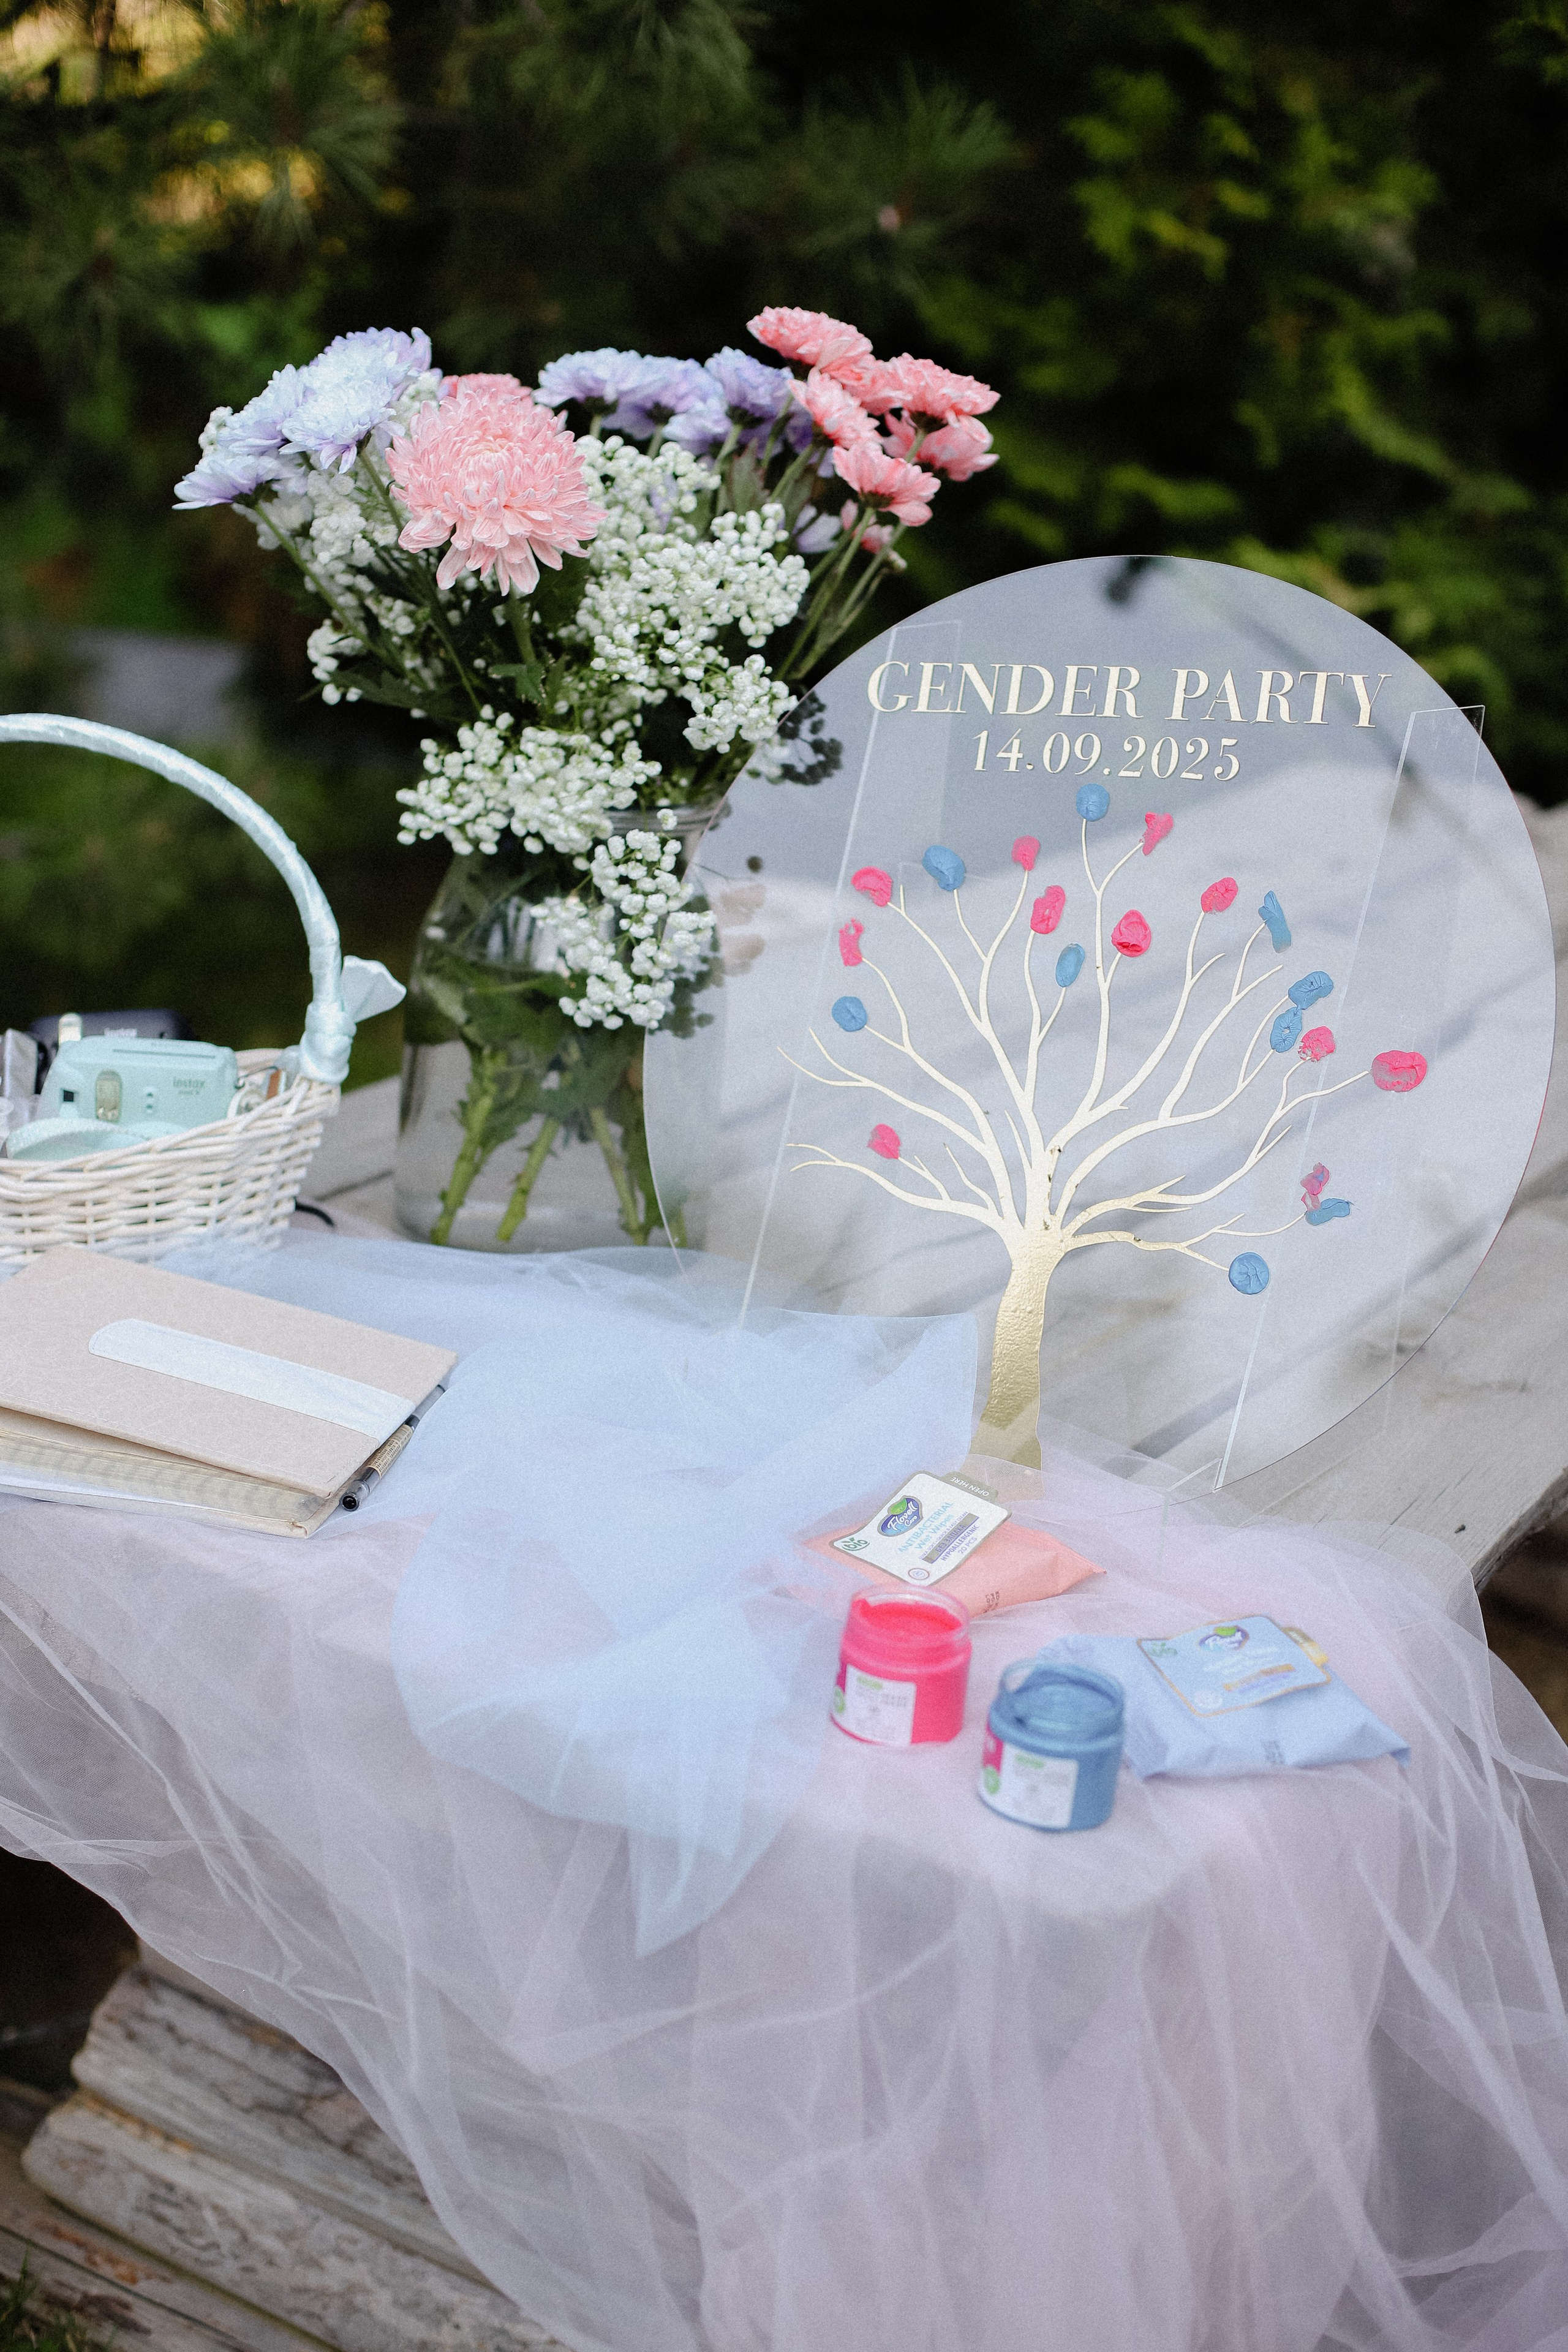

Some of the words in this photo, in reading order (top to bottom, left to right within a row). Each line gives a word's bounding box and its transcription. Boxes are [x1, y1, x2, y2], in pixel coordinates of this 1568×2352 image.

[866, 660, 1144, 719] GENDER
[1164, 668, 1392, 728] PARTY
[972, 729, 1240, 782] 14.09.2025
[950, 1476, 969, 1488] HERE
[968, 1485, 989, 1496] OPEN
[887, 1501, 918, 1531] Flovell
[898, 1502, 954, 1553] ANTIBACTERIAL
[914, 1534, 932, 1548] Wet
[928, 1514, 954, 1534] Wipes
[843, 1539, 869, 1549] bio
[935, 1542, 947, 1552] БЕЗ
[944, 1525, 966, 1542] ЗАПАХА
[940, 1525, 980, 1561] HYPOALLERGENIC
[965, 1536, 977, 1547] PCS
